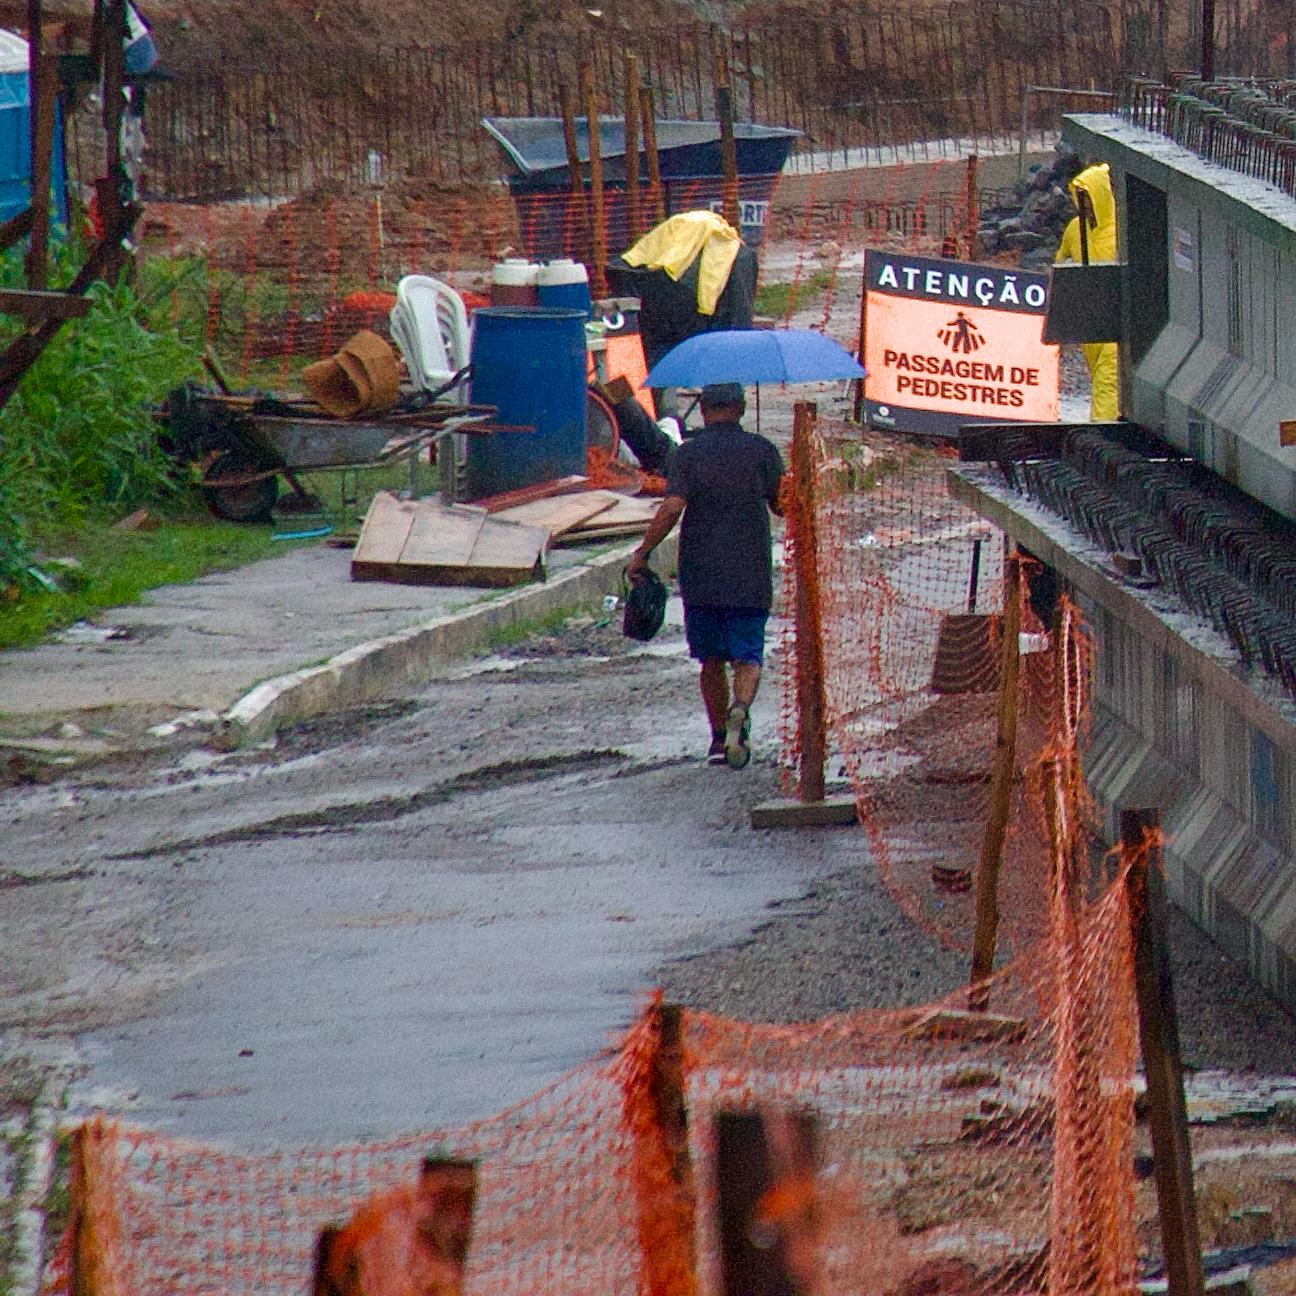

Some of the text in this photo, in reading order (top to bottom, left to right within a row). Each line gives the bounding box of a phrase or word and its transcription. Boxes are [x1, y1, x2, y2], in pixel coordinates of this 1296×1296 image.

[878, 264, 1046, 307] ATENÇÃO
[884, 349, 1041, 387] PASSAGEM DE
[896, 375, 1025, 408] PEDESTRES
